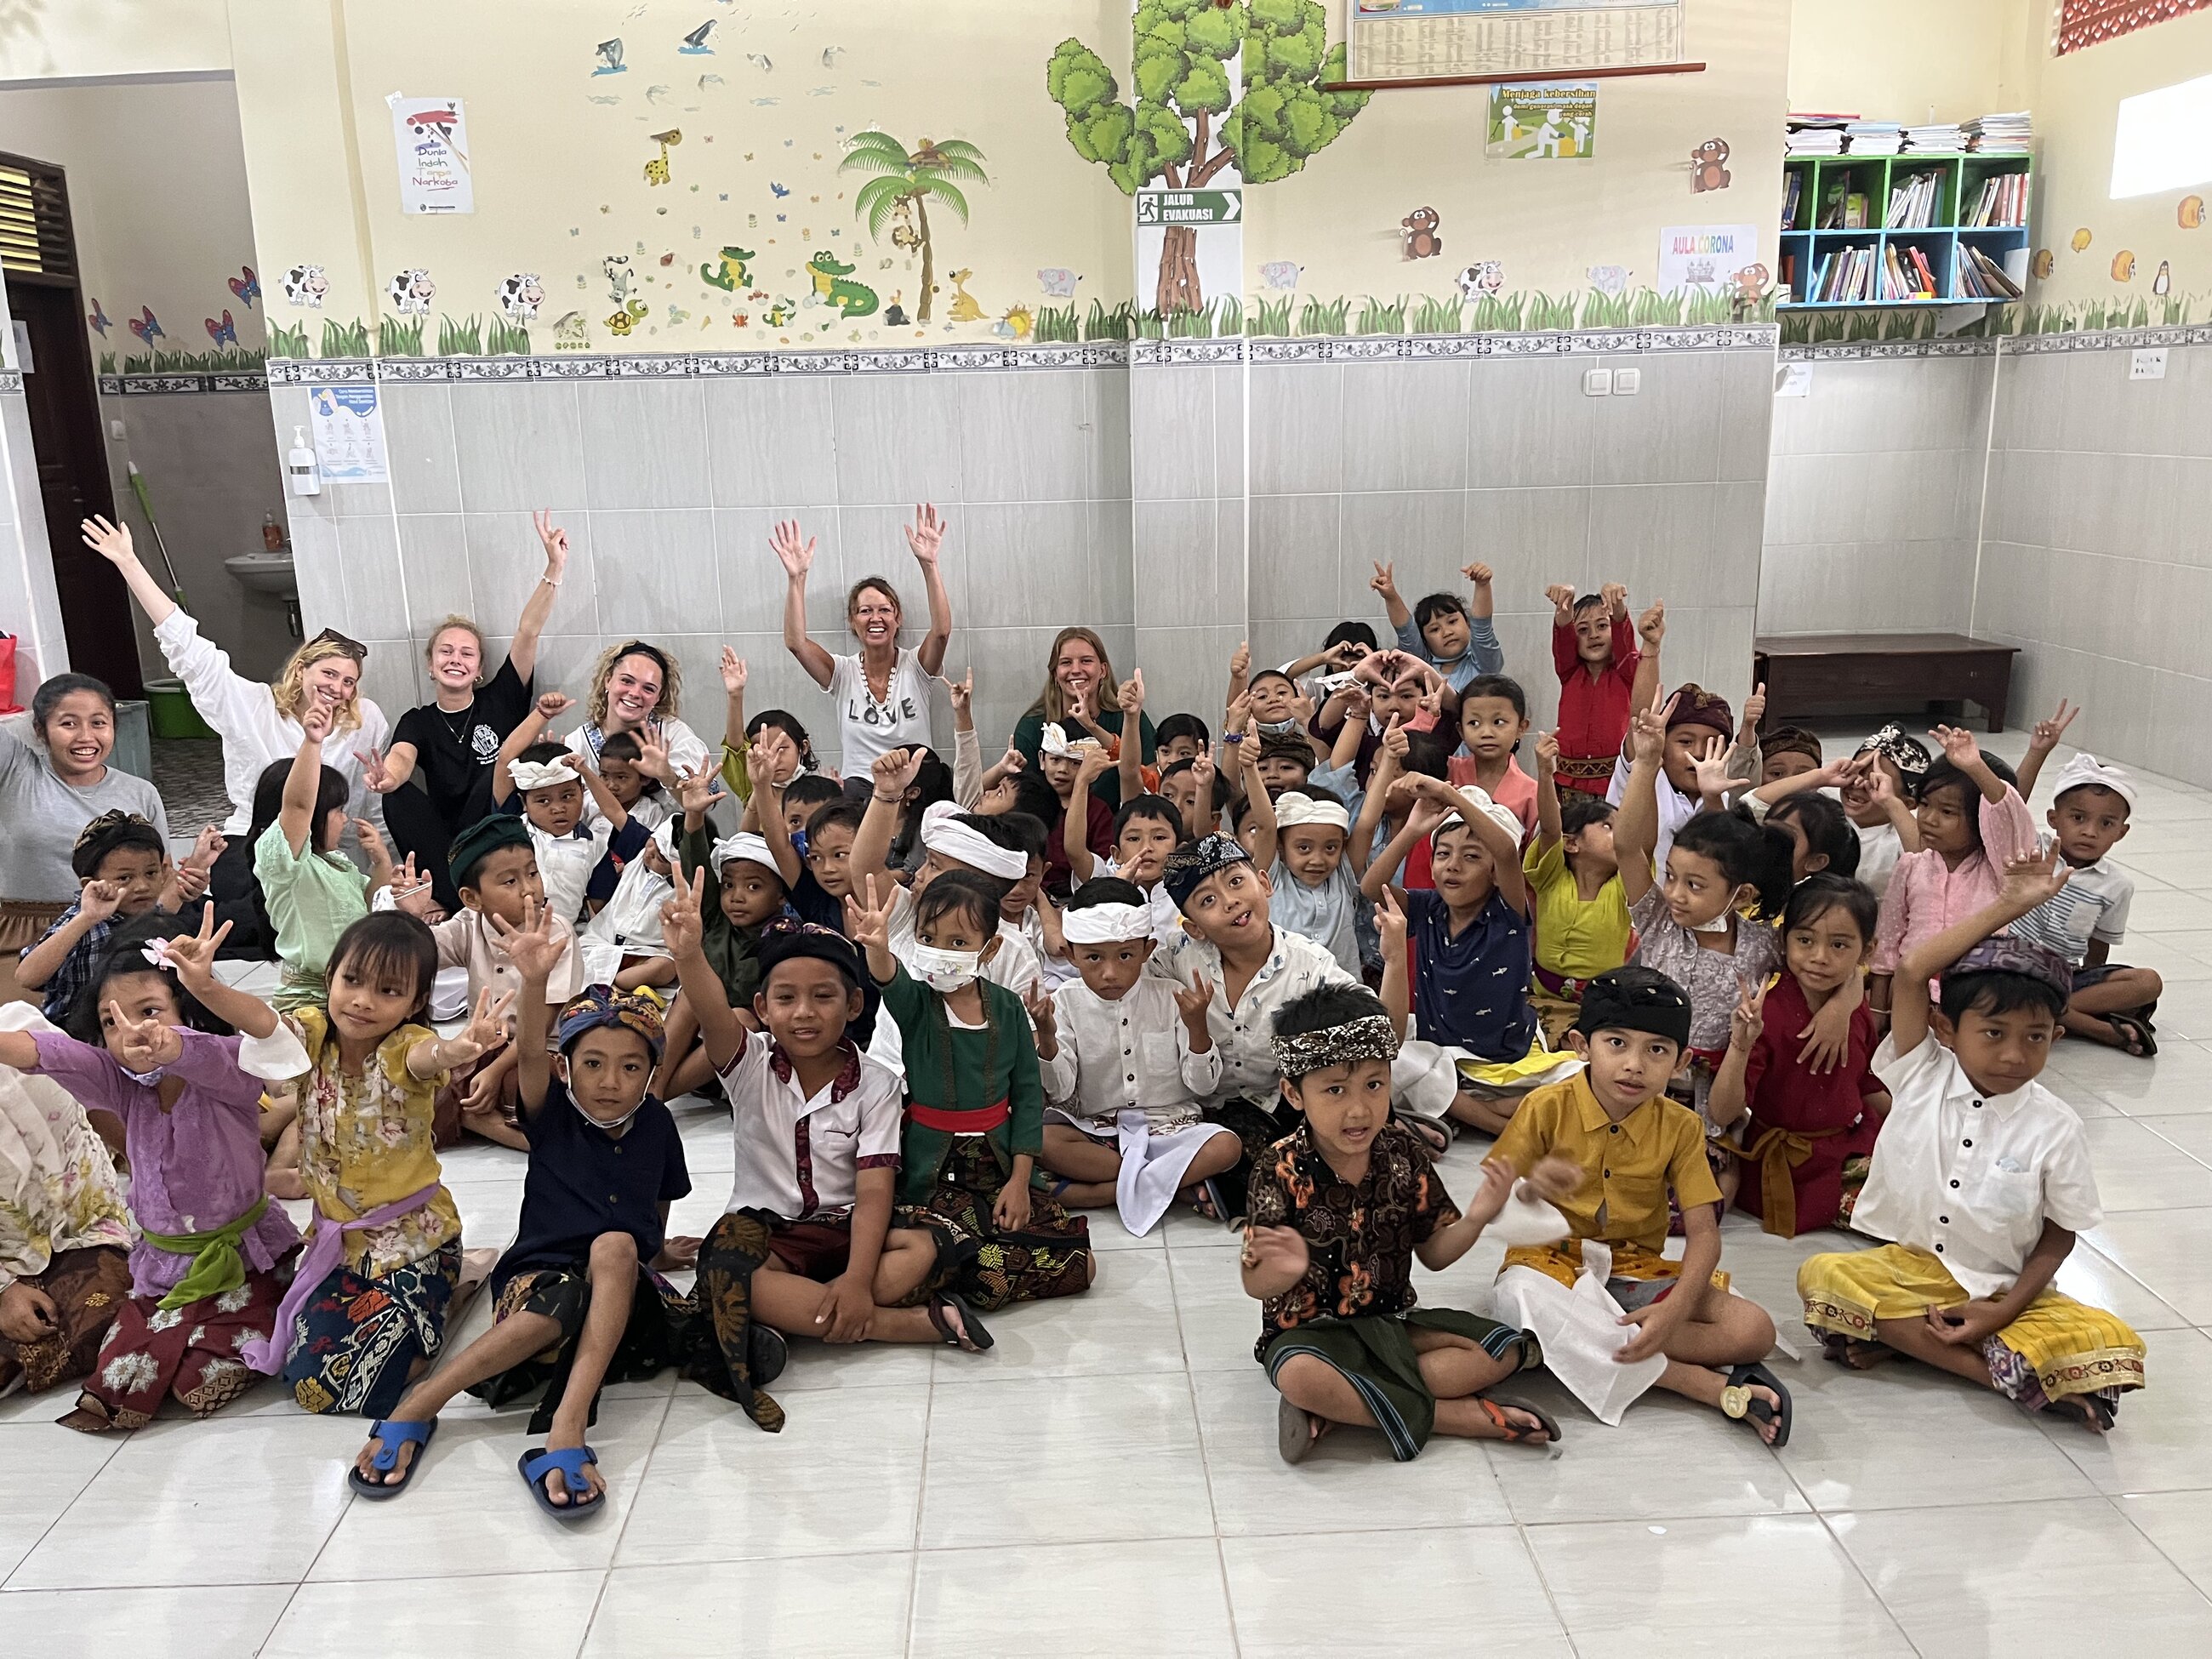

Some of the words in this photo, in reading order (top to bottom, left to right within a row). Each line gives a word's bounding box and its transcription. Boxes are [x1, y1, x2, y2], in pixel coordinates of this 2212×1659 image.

[1502, 89, 1541, 100] Menjaga
[1543, 88, 1596, 99] kebersihan
[418, 146, 447, 157] Dunia
[418, 157, 448, 168] Indah
[416, 168, 452, 179] Tanpa
[413, 177, 459, 186] Narkoba
[1163, 194, 1194, 206] JALUR
[1163, 208, 1213, 221] EVAKUASI
[1673, 237, 1697, 255] AULA
[1698, 235, 1734, 254] CORONA
[848, 697, 916, 724] LOVE
